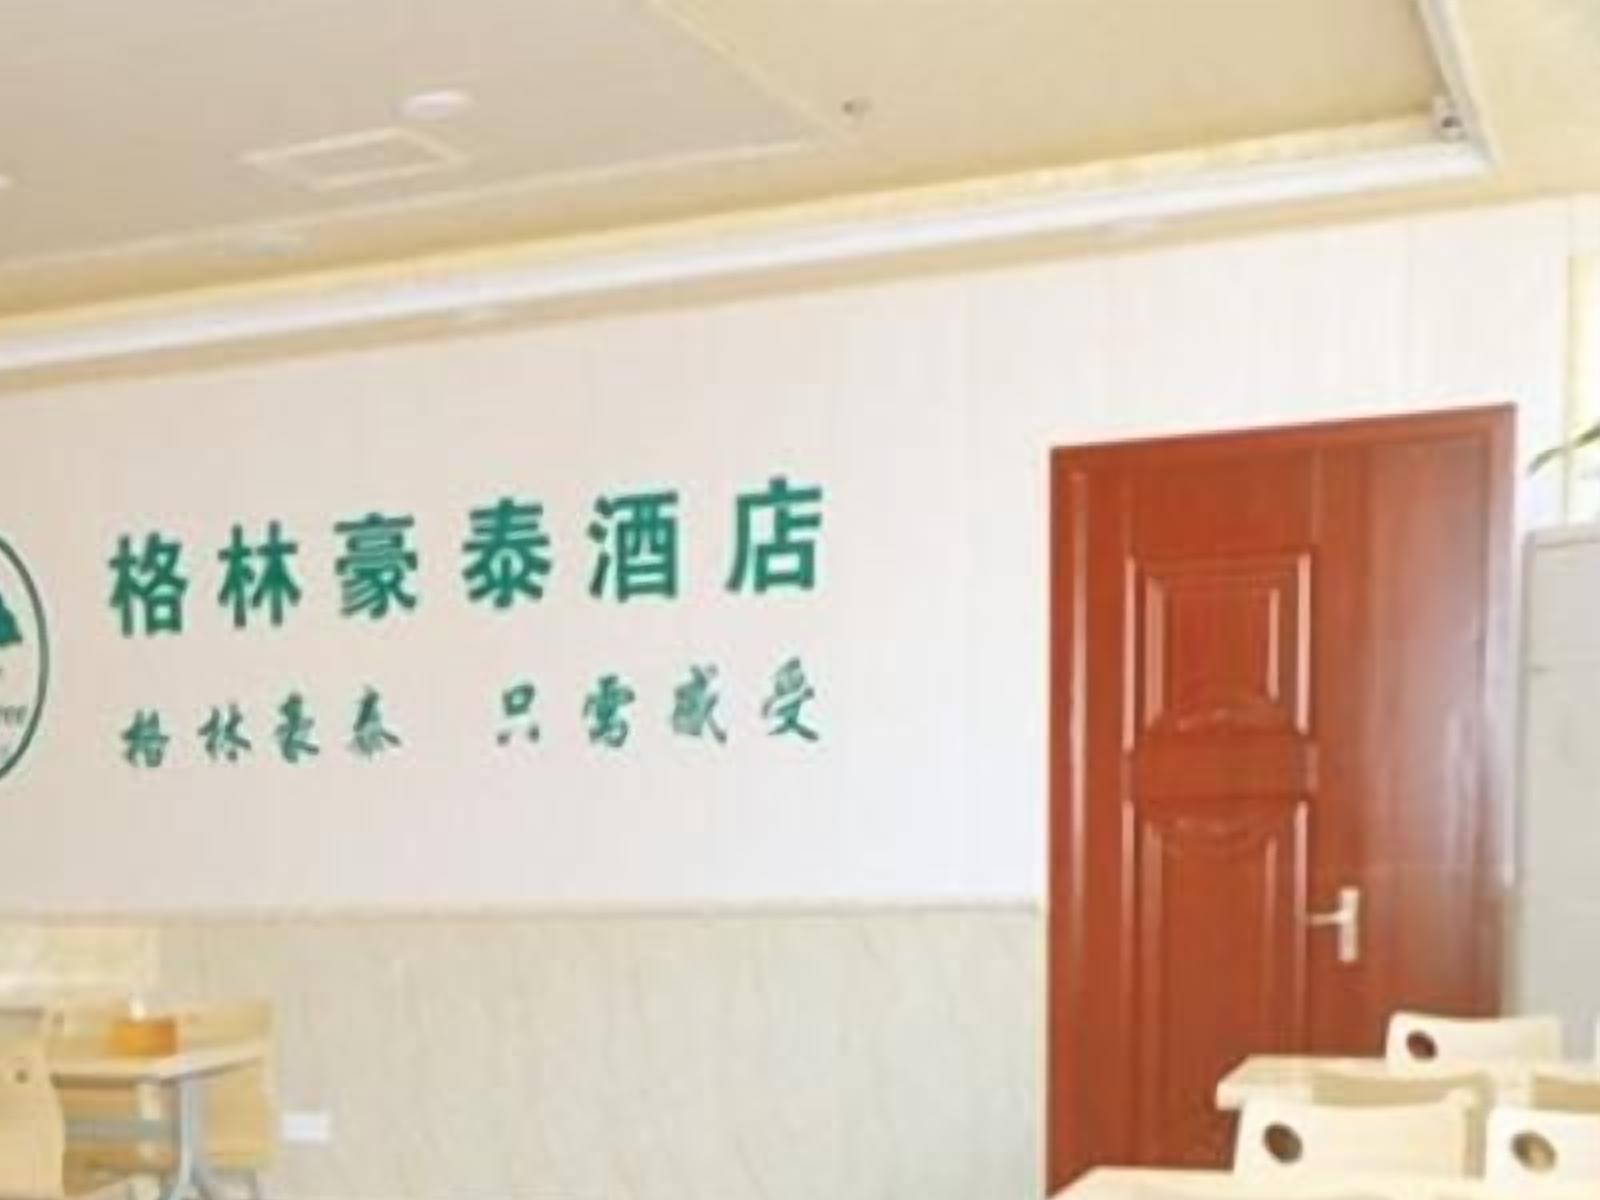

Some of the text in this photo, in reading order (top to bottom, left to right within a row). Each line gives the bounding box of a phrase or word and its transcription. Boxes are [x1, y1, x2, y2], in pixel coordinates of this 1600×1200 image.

[108, 476, 823, 638] 格林豪泰酒店
[119, 656, 820, 768] 格林豪泰 只需感受
